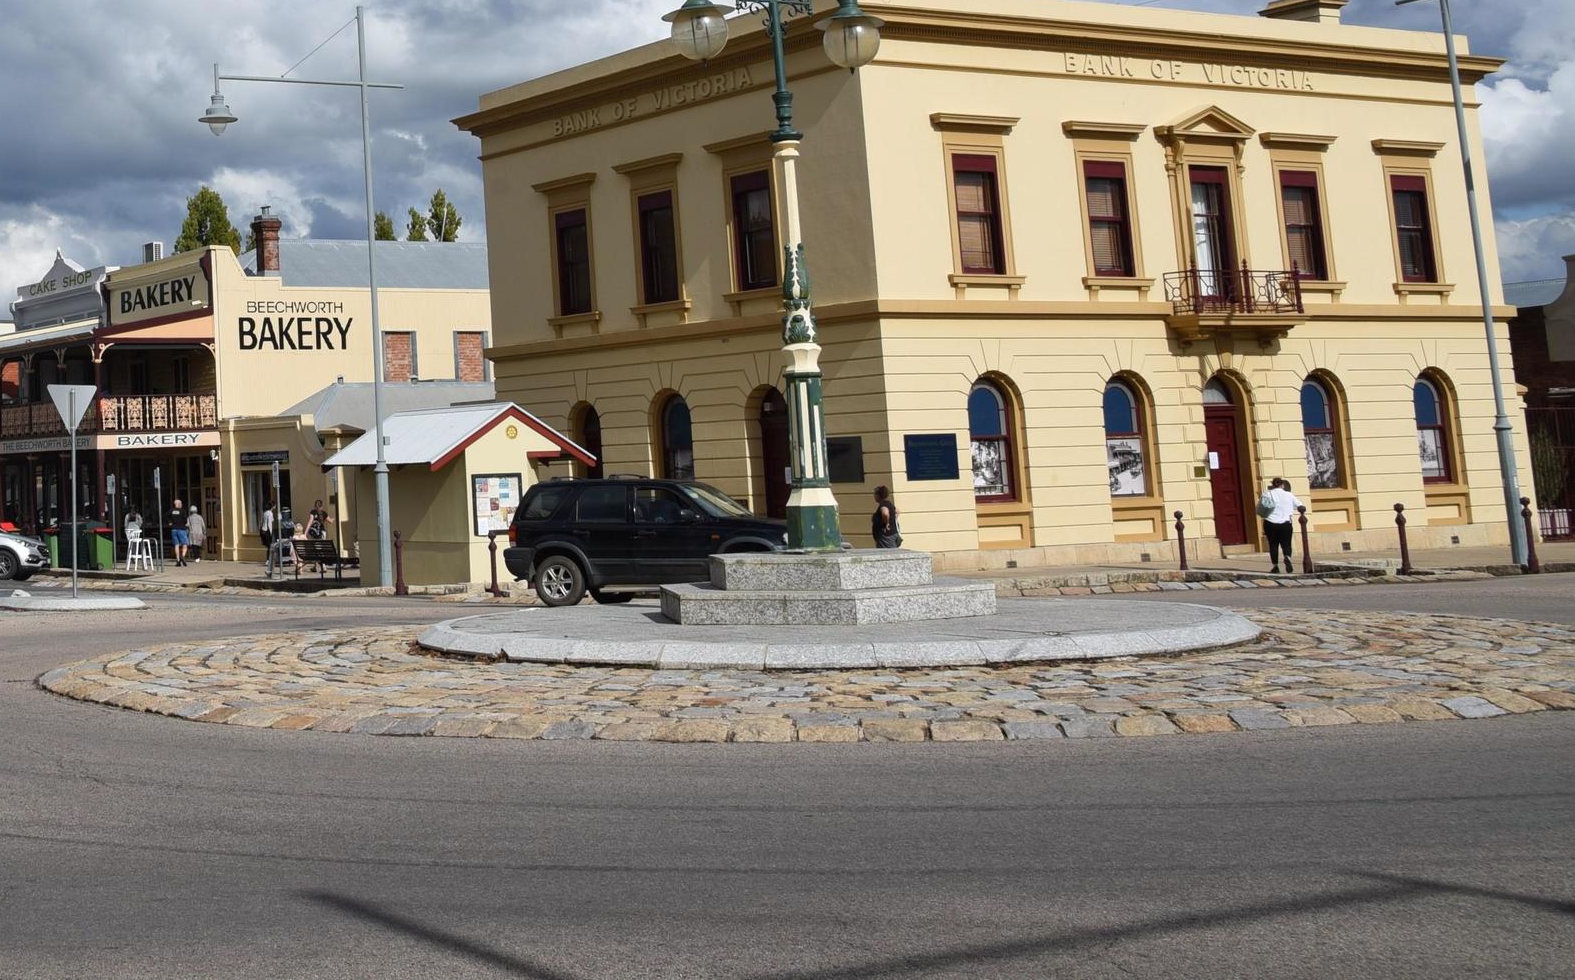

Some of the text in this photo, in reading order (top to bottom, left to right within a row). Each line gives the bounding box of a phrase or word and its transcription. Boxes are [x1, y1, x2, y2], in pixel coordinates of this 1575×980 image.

[1063, 52, 1314, 90] BANK OF VICTORIA
[553, 67, 753, 136] BANK OF VICTORIA
[29, 271, 92, 296] CAKE SHOP
[120, 275, 195, 314] BAKERY
[246, 301, 343, 314] BEECHWORTH
[238, 317, 353, 350] BAKERY
[3, 437, 90, 451] THE BEECHWORTH BAERY
[117, 434, 200, 446] BAKERY
